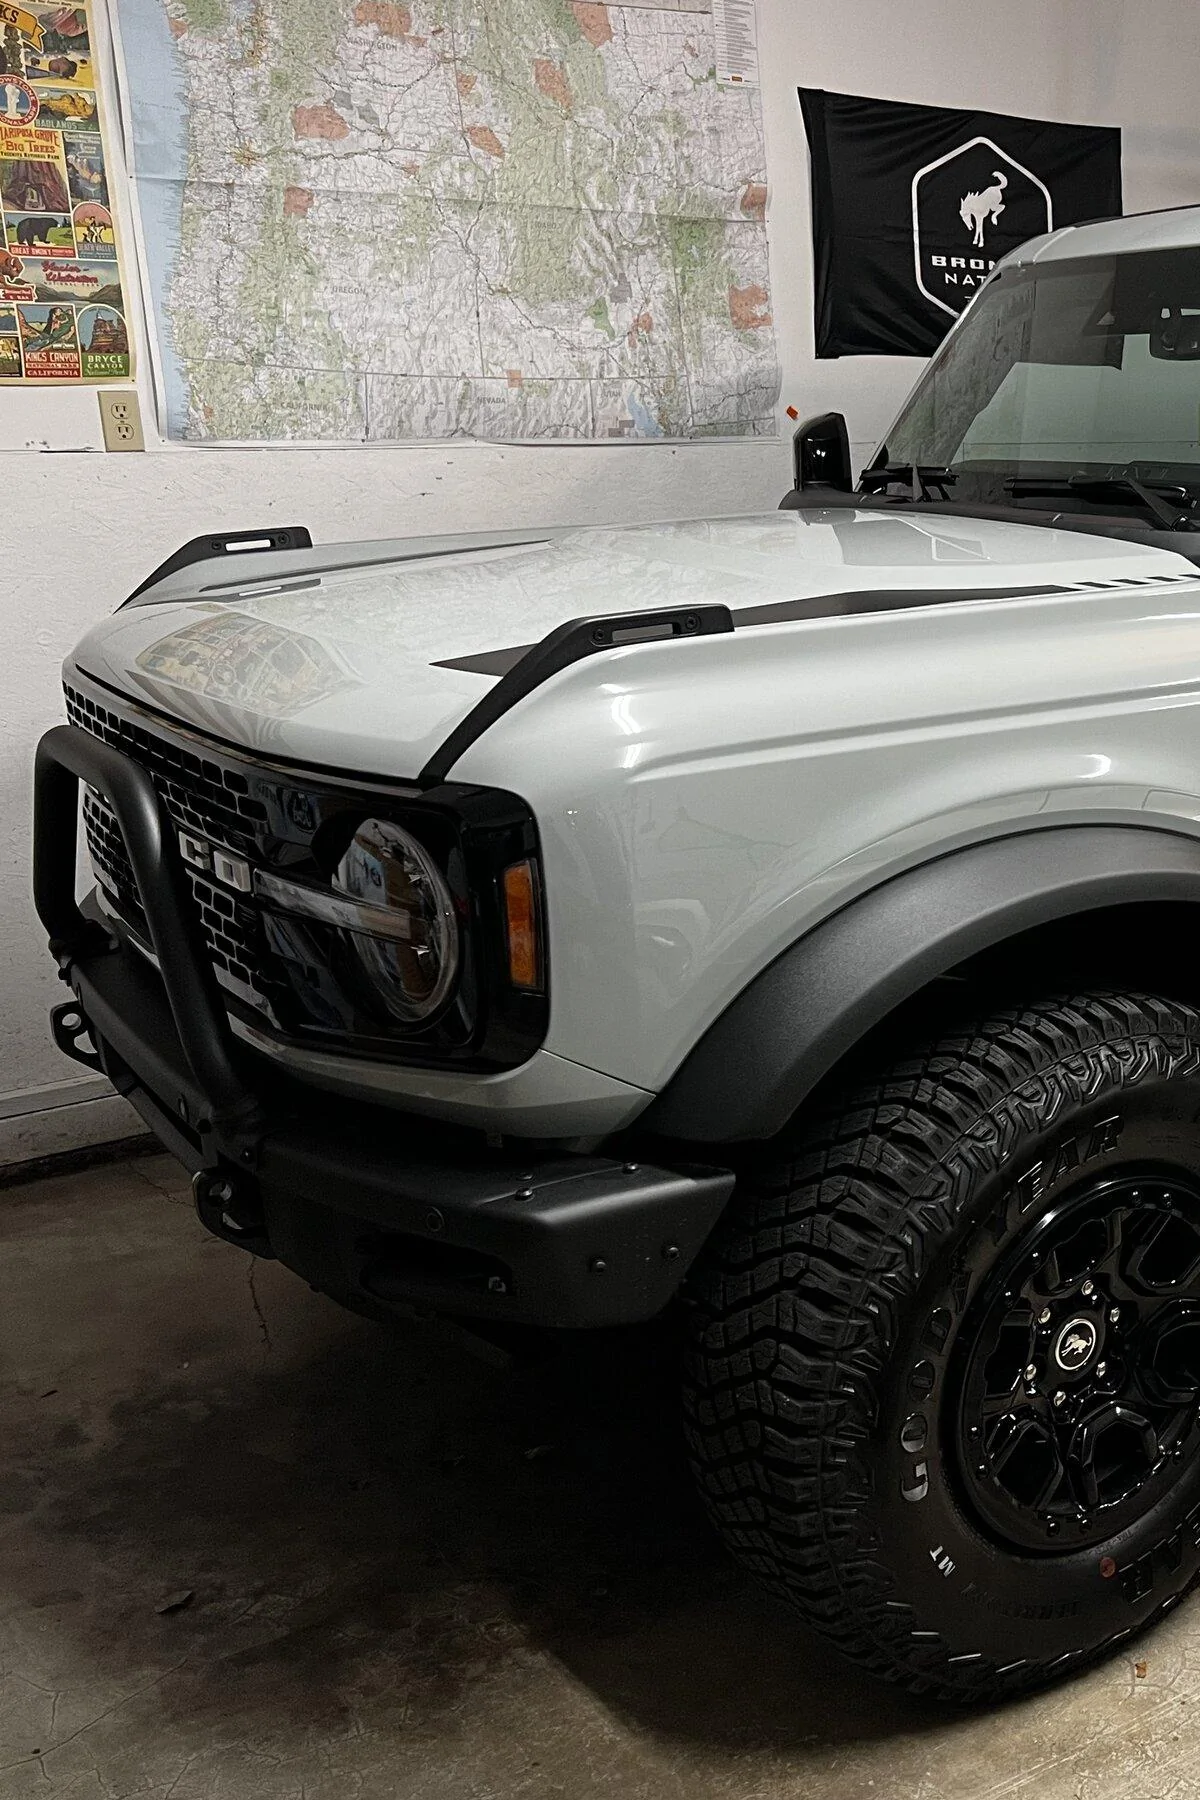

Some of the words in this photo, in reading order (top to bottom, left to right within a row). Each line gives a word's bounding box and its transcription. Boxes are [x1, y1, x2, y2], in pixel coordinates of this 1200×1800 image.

[35, 119, 77, 130] BADLANDS
[25, 352, 47, 361] KINGS
[49, 352, 79, 362] CANYON
[87, 355, 122, 363] BRYCE
[929, 1545, 957, 1579] MT
